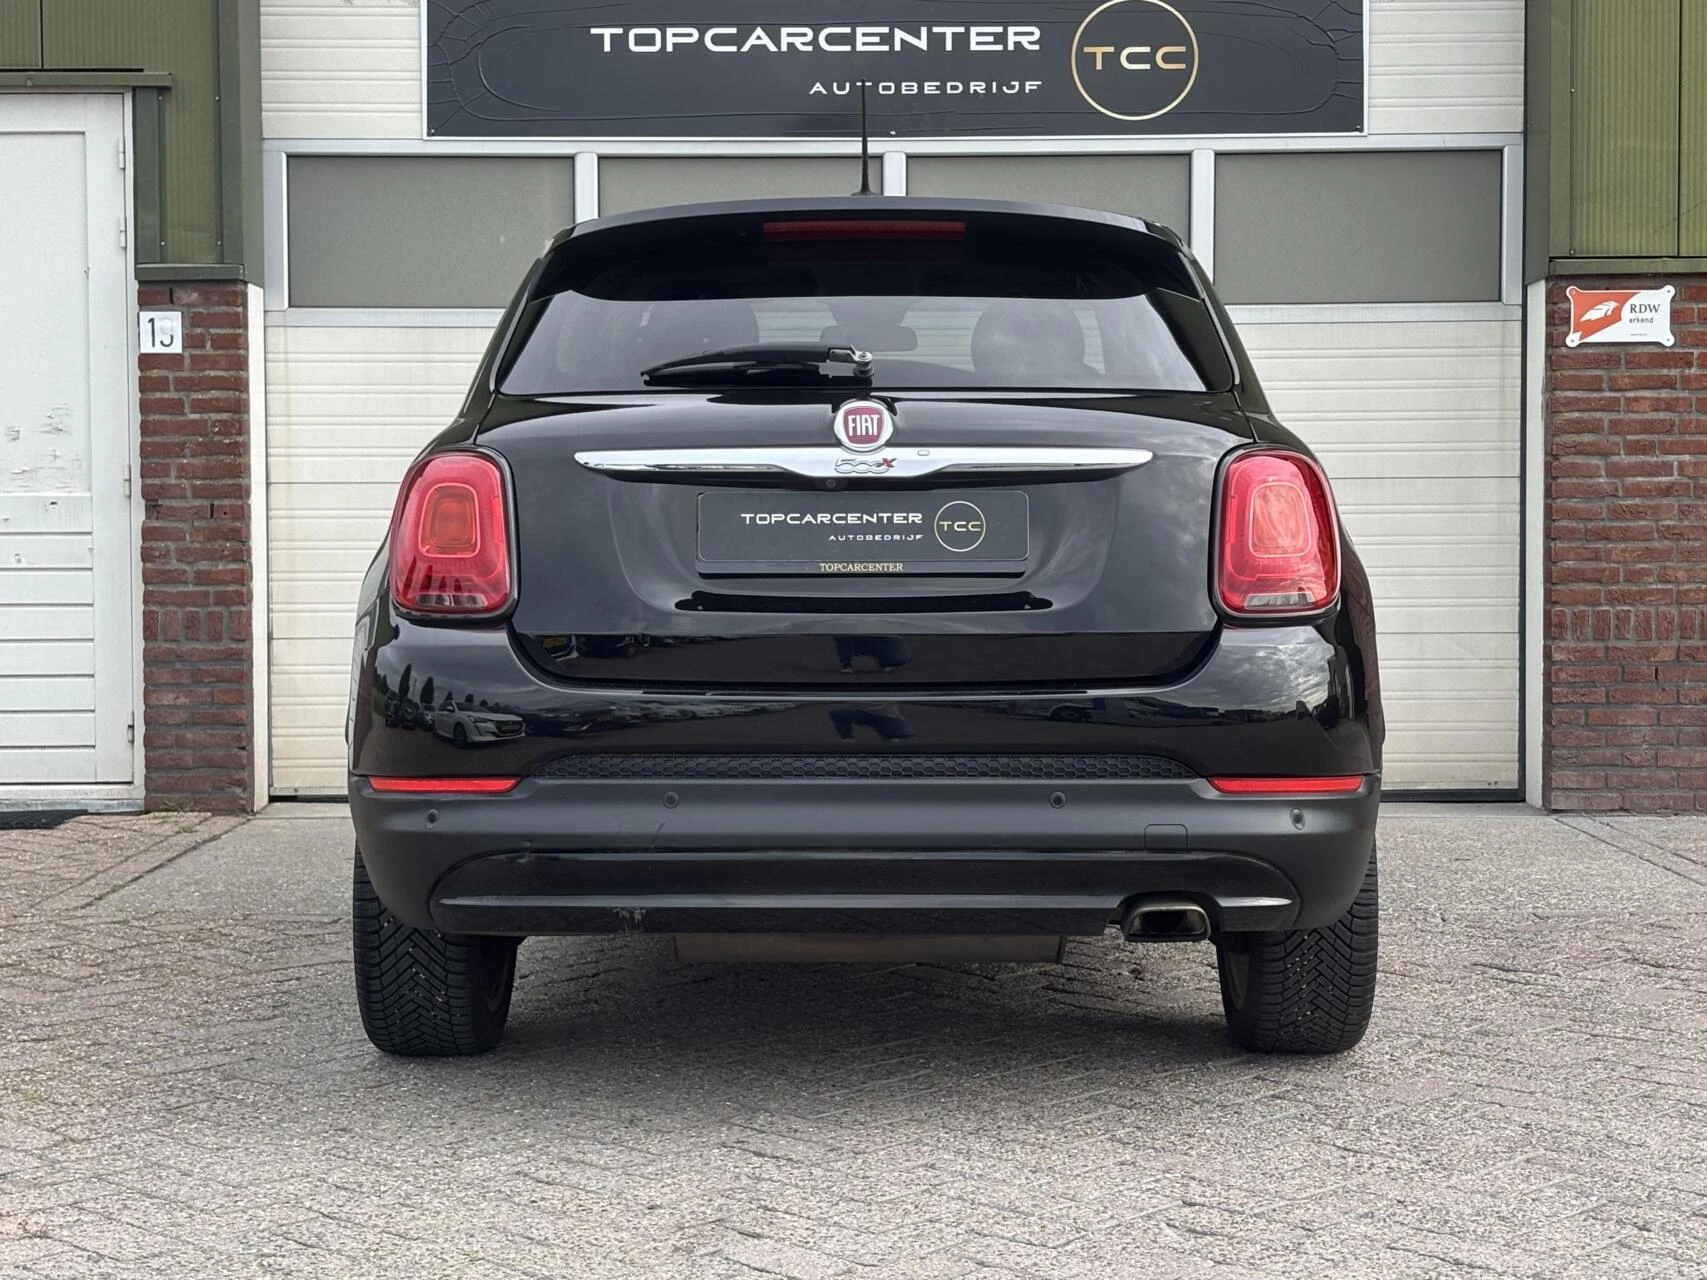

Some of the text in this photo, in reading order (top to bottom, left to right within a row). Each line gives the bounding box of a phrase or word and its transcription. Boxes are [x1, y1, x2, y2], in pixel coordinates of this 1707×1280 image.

[590, 25, 1042, 53] TOPCARCENTER
[1083, 46, 1187, 71] TCC
[1629, 303, 1661, 314] RDW
[1628, 316, 1654, 324] erkend
[847, 413, 880, 437] FIAT
[740, 512, 923, 525] TOPCARCENTER
[939, 520, 982, 532] TCC
[819, 562, 904, 572] TOPCARCENTER
